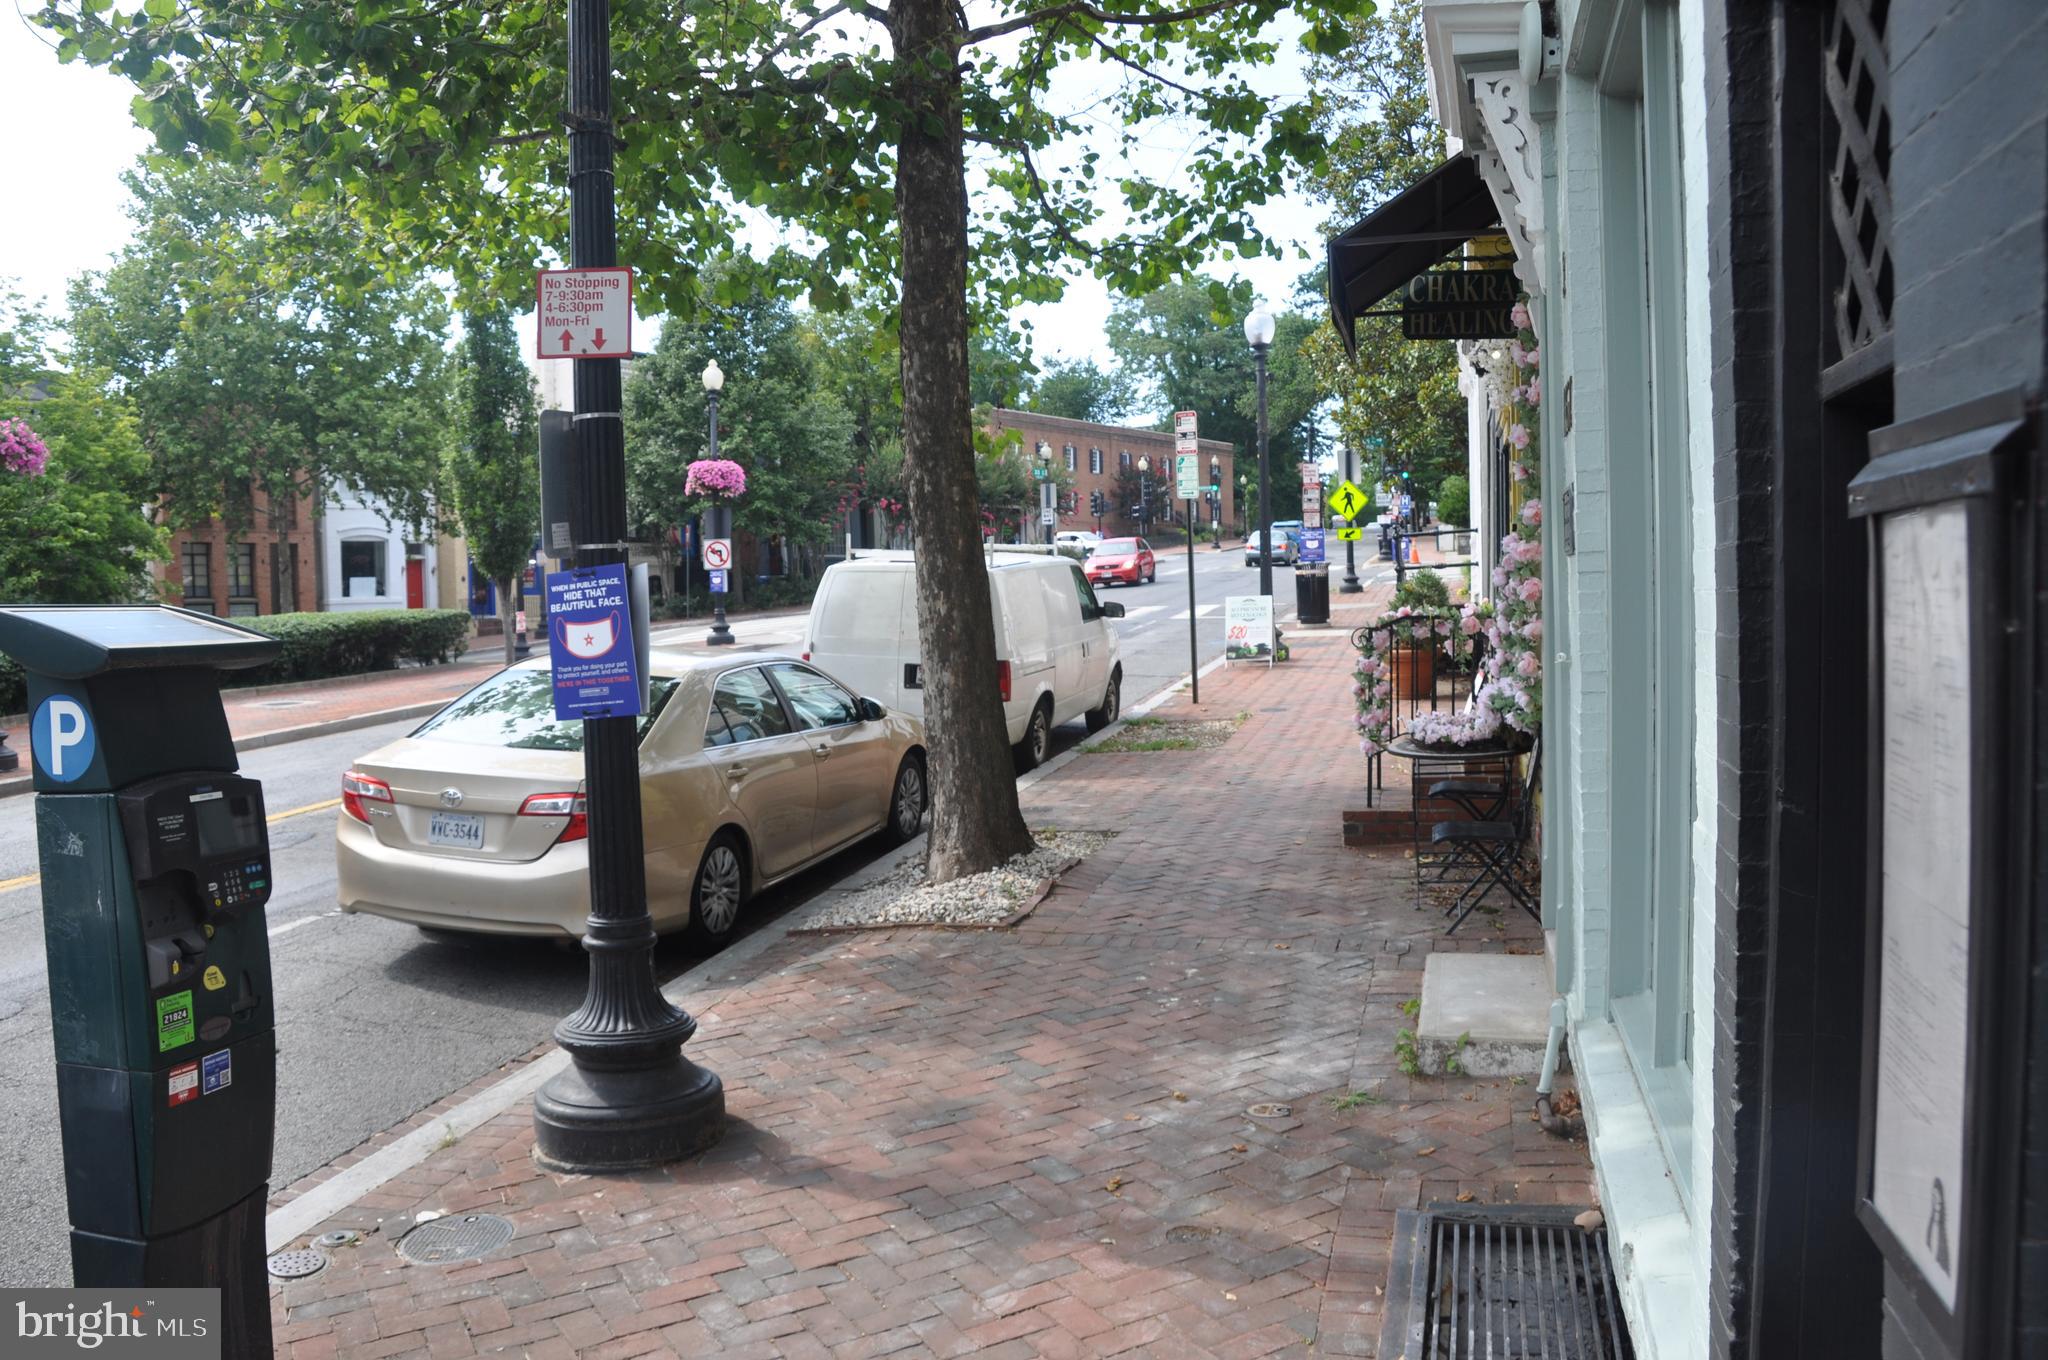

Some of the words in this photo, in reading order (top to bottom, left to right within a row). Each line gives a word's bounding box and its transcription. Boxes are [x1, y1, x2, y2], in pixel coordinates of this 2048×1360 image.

[545, 278, 561, 289] No
[565, 276, 619, 290] Stopping
[1409, 274, 1514, 302] CHAKRA
[545, 290, 603, 301] 7-9:30am
[546, 302, 603, 313] 4-6:30pm
[545, 315, 589, 327] Mon-Fri
[1410, 309, 1515, 335] HEALING
[551, 584, 568, 592] WHEN
[577, 580, 597, 589] PUBLIC
[563, 590, 583, 600] HIDE
[584, 587, 607, 598] THAT
[550, 600, 597, 613] BEAUTIFUL
[598, 595, 624, 607] FACE.
[1227, 625, 1248, 640] $20
[49, 700, 86, 775] P
[164, 1009, 187, 1024] 21824
